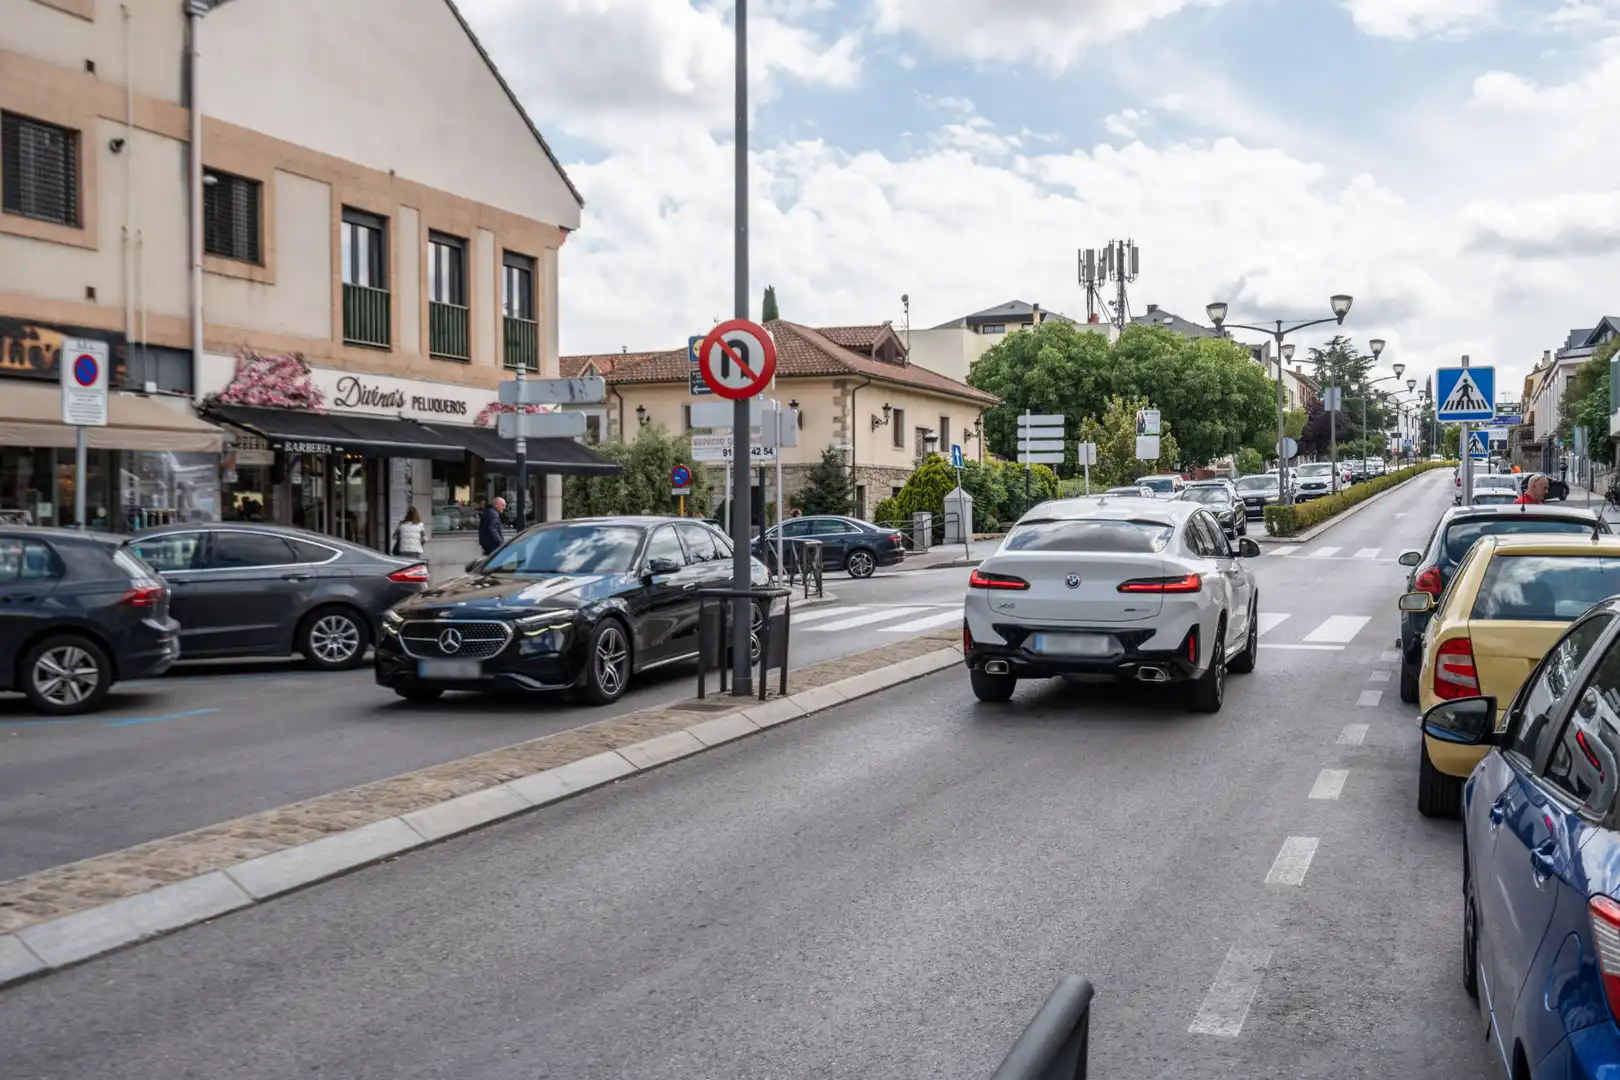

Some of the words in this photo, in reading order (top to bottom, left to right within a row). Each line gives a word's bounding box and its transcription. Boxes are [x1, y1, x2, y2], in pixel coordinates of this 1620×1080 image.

[334, 376, 405, 408] Divina's
[411, 395, 467, 415] PELUQUEROS
[722, 448, 732, 457] 91
[751, 447, 761, 456] 42
[763, 447, 773, 456] 54
